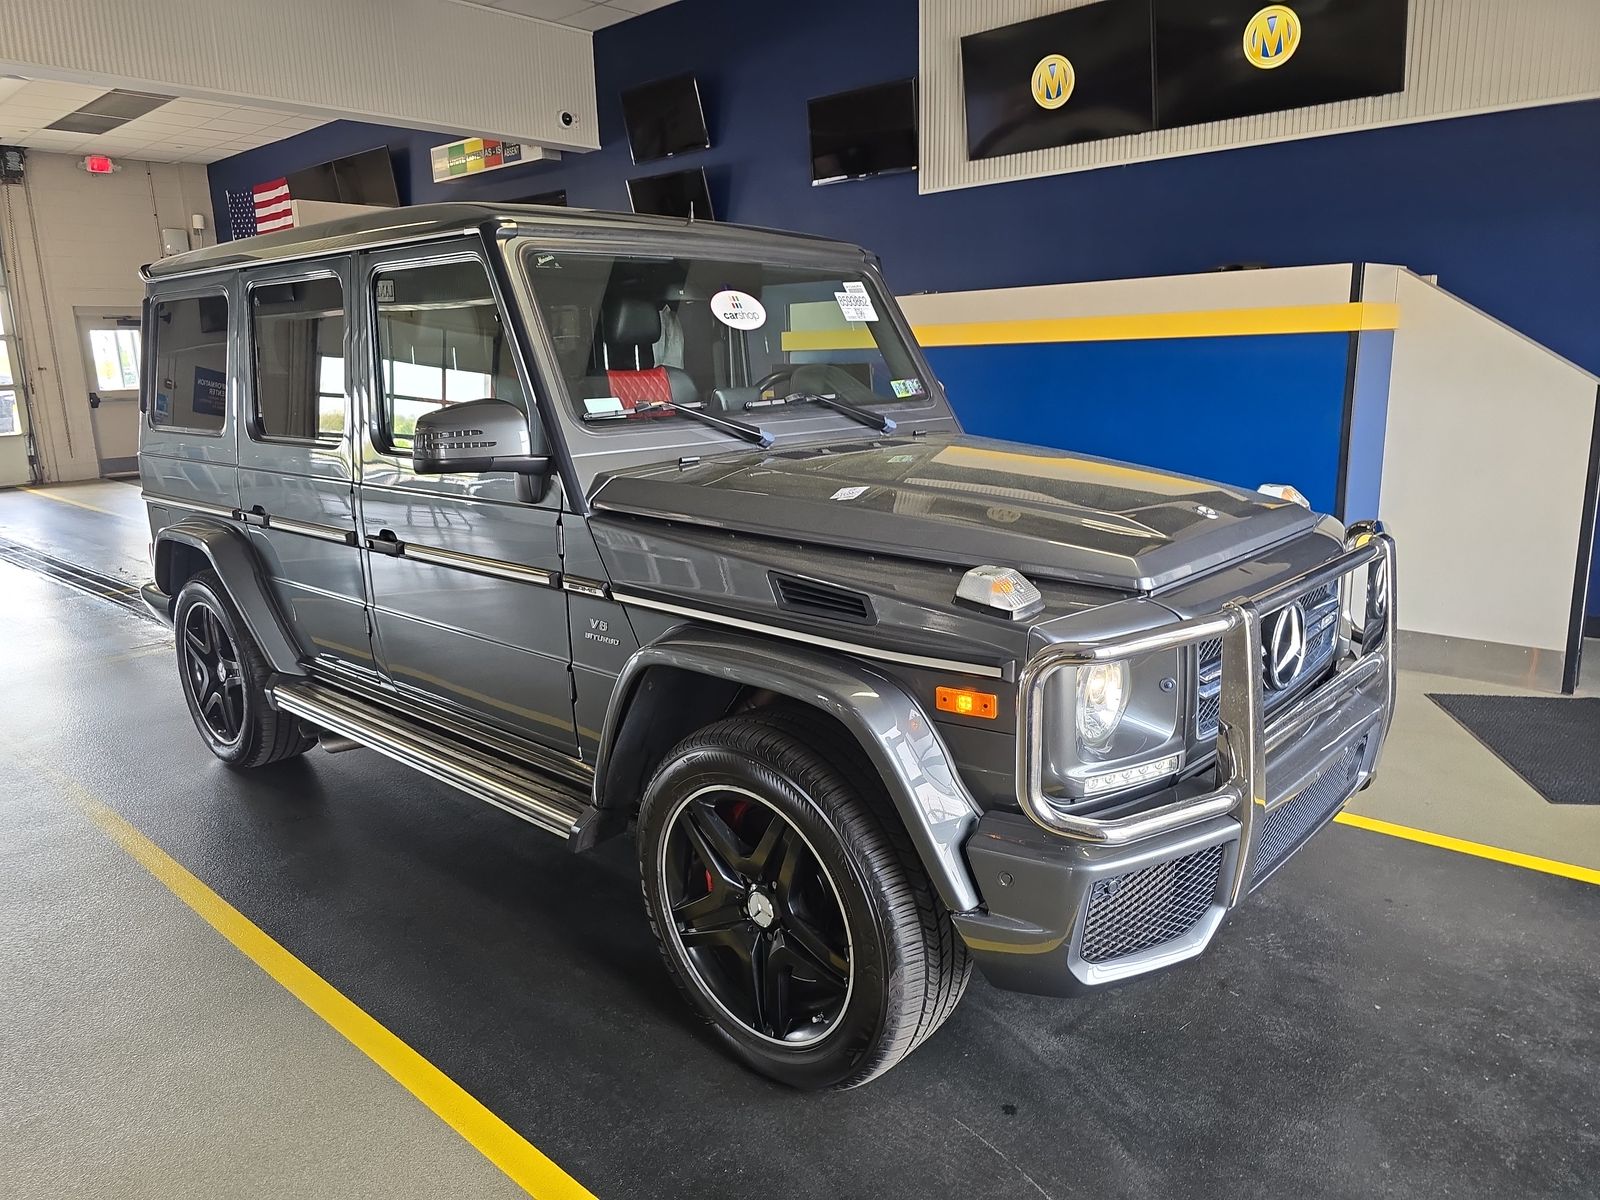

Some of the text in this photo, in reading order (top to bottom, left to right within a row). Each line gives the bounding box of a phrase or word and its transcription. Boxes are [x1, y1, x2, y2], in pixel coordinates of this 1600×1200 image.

[1248, 11, 1295, 62] M
[1035, 59, 1070, 102] M
[723, 311, 760, 322] carshop
[589, 618, 608, 632] V8
